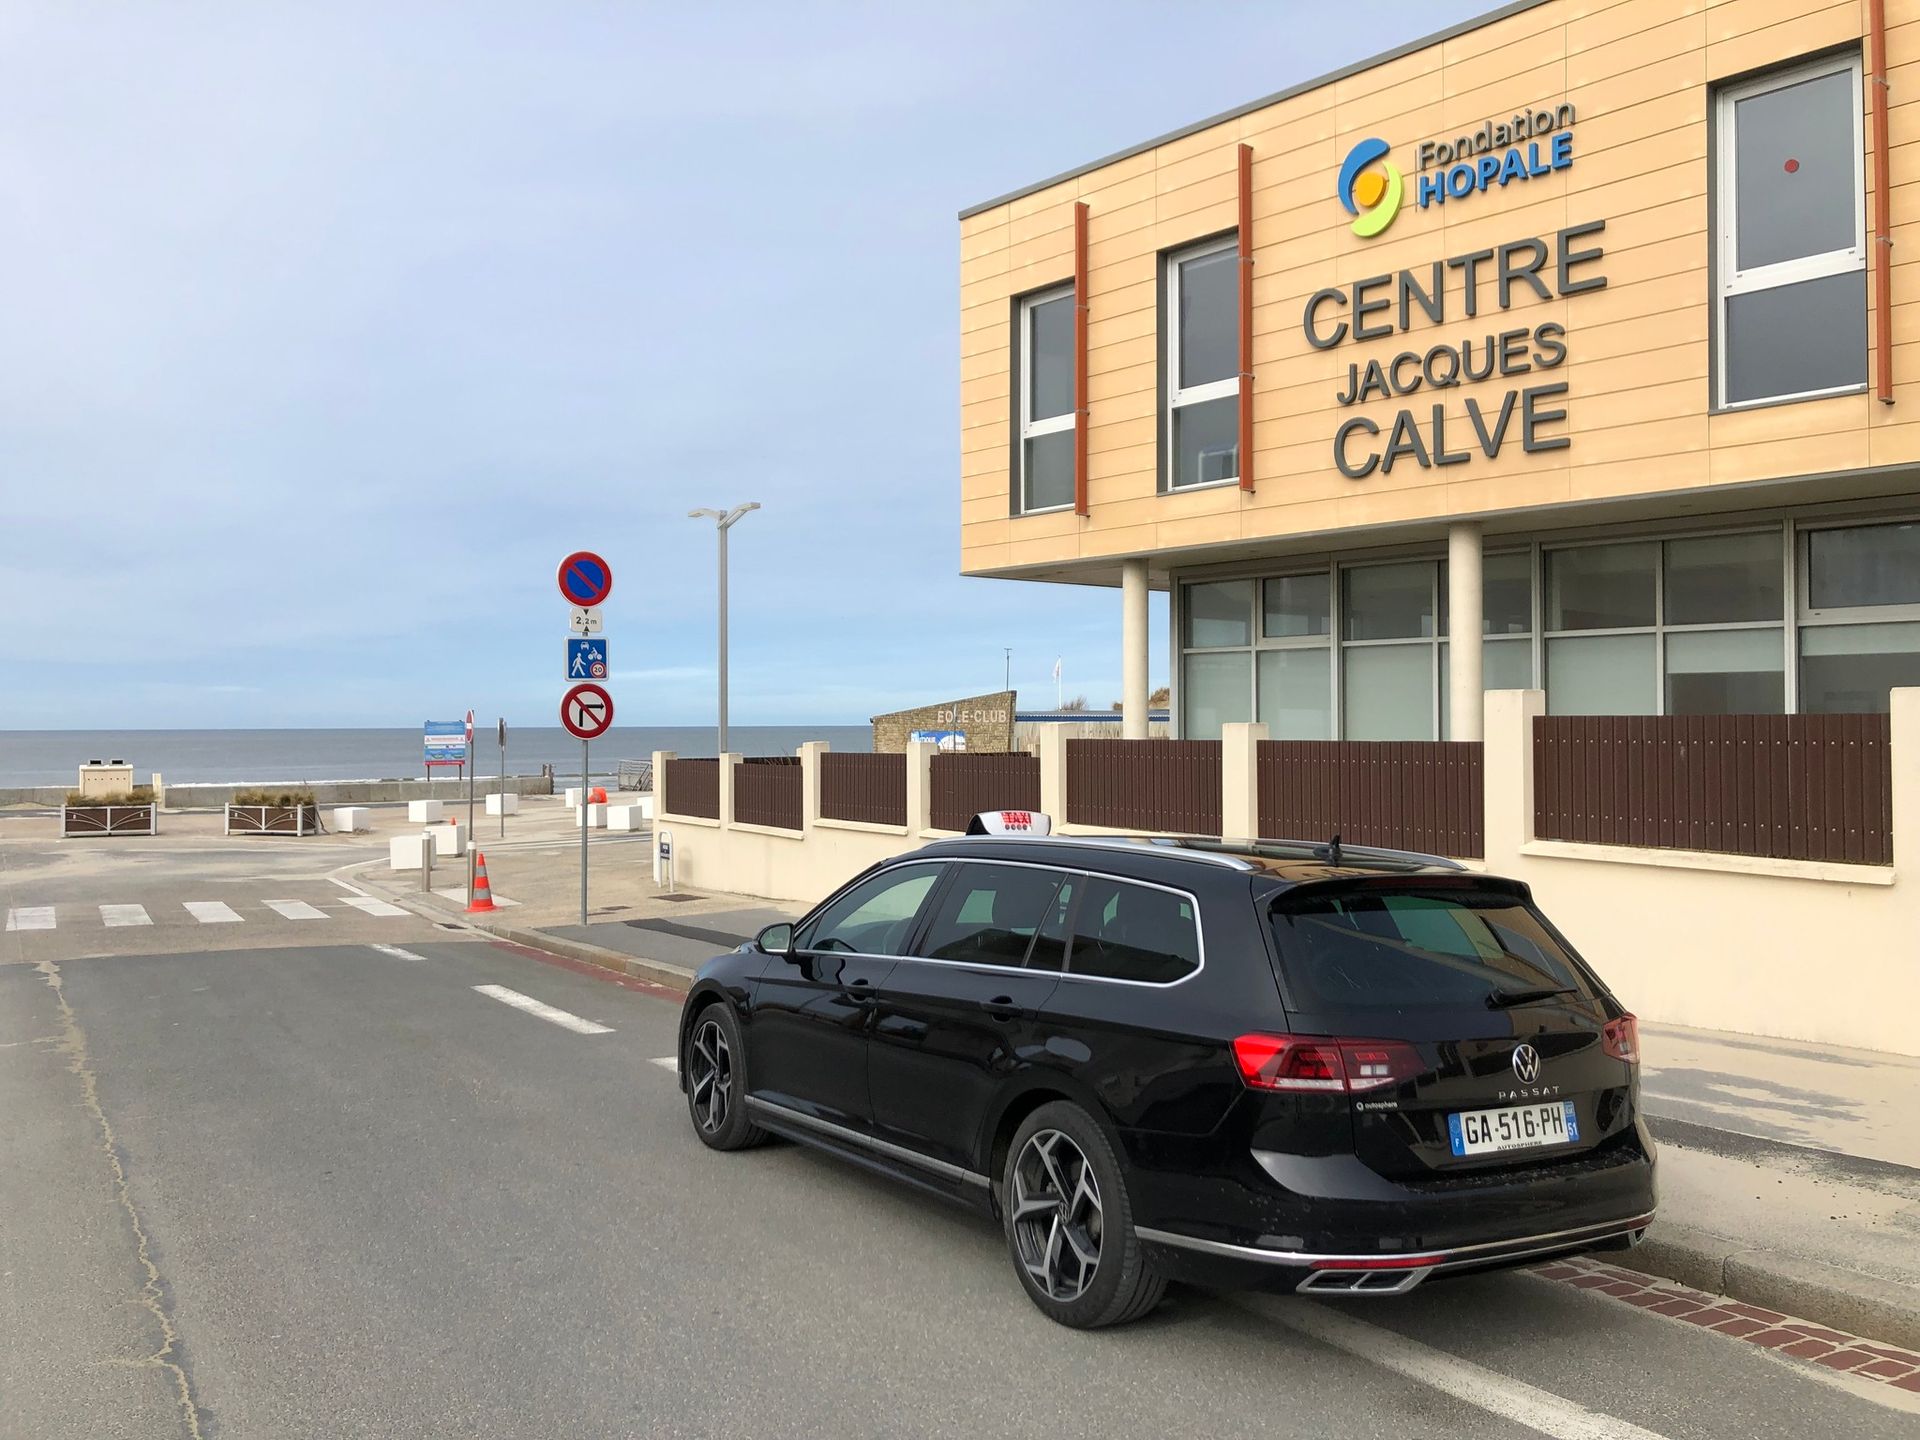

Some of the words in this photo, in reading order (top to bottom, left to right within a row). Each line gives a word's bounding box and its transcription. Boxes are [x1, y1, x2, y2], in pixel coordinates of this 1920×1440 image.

[1418, 102, 1576, 171] Fondation
[1419, 131, 1574, 209] HOPALE
[1303, 219, 1608, 350] CENTRE
[1337, 322, 1567, 404] JACQUES
[1333, 381, 1571, 479] CALVE
[1498, 1085, 1560, 1100] PASSAT
[1568, 1122, 1578, 1136] 51
